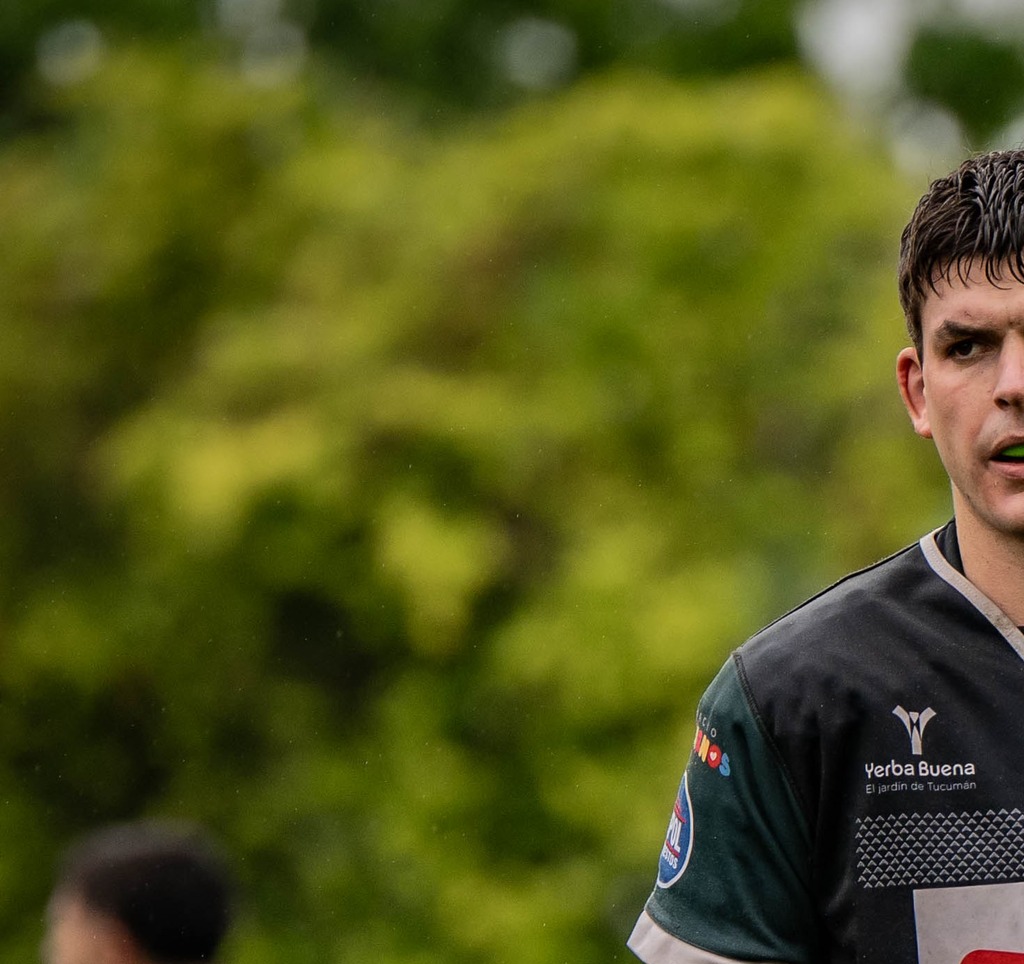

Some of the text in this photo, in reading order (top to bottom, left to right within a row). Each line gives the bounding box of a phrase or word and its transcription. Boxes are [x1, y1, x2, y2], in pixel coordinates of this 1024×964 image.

[865, 759, 976, 779] Yerba Buena
[866, 784, 875, 794] El
[911, 781, 925, 791] de
[927, 779, 977, 792] Tucumán
